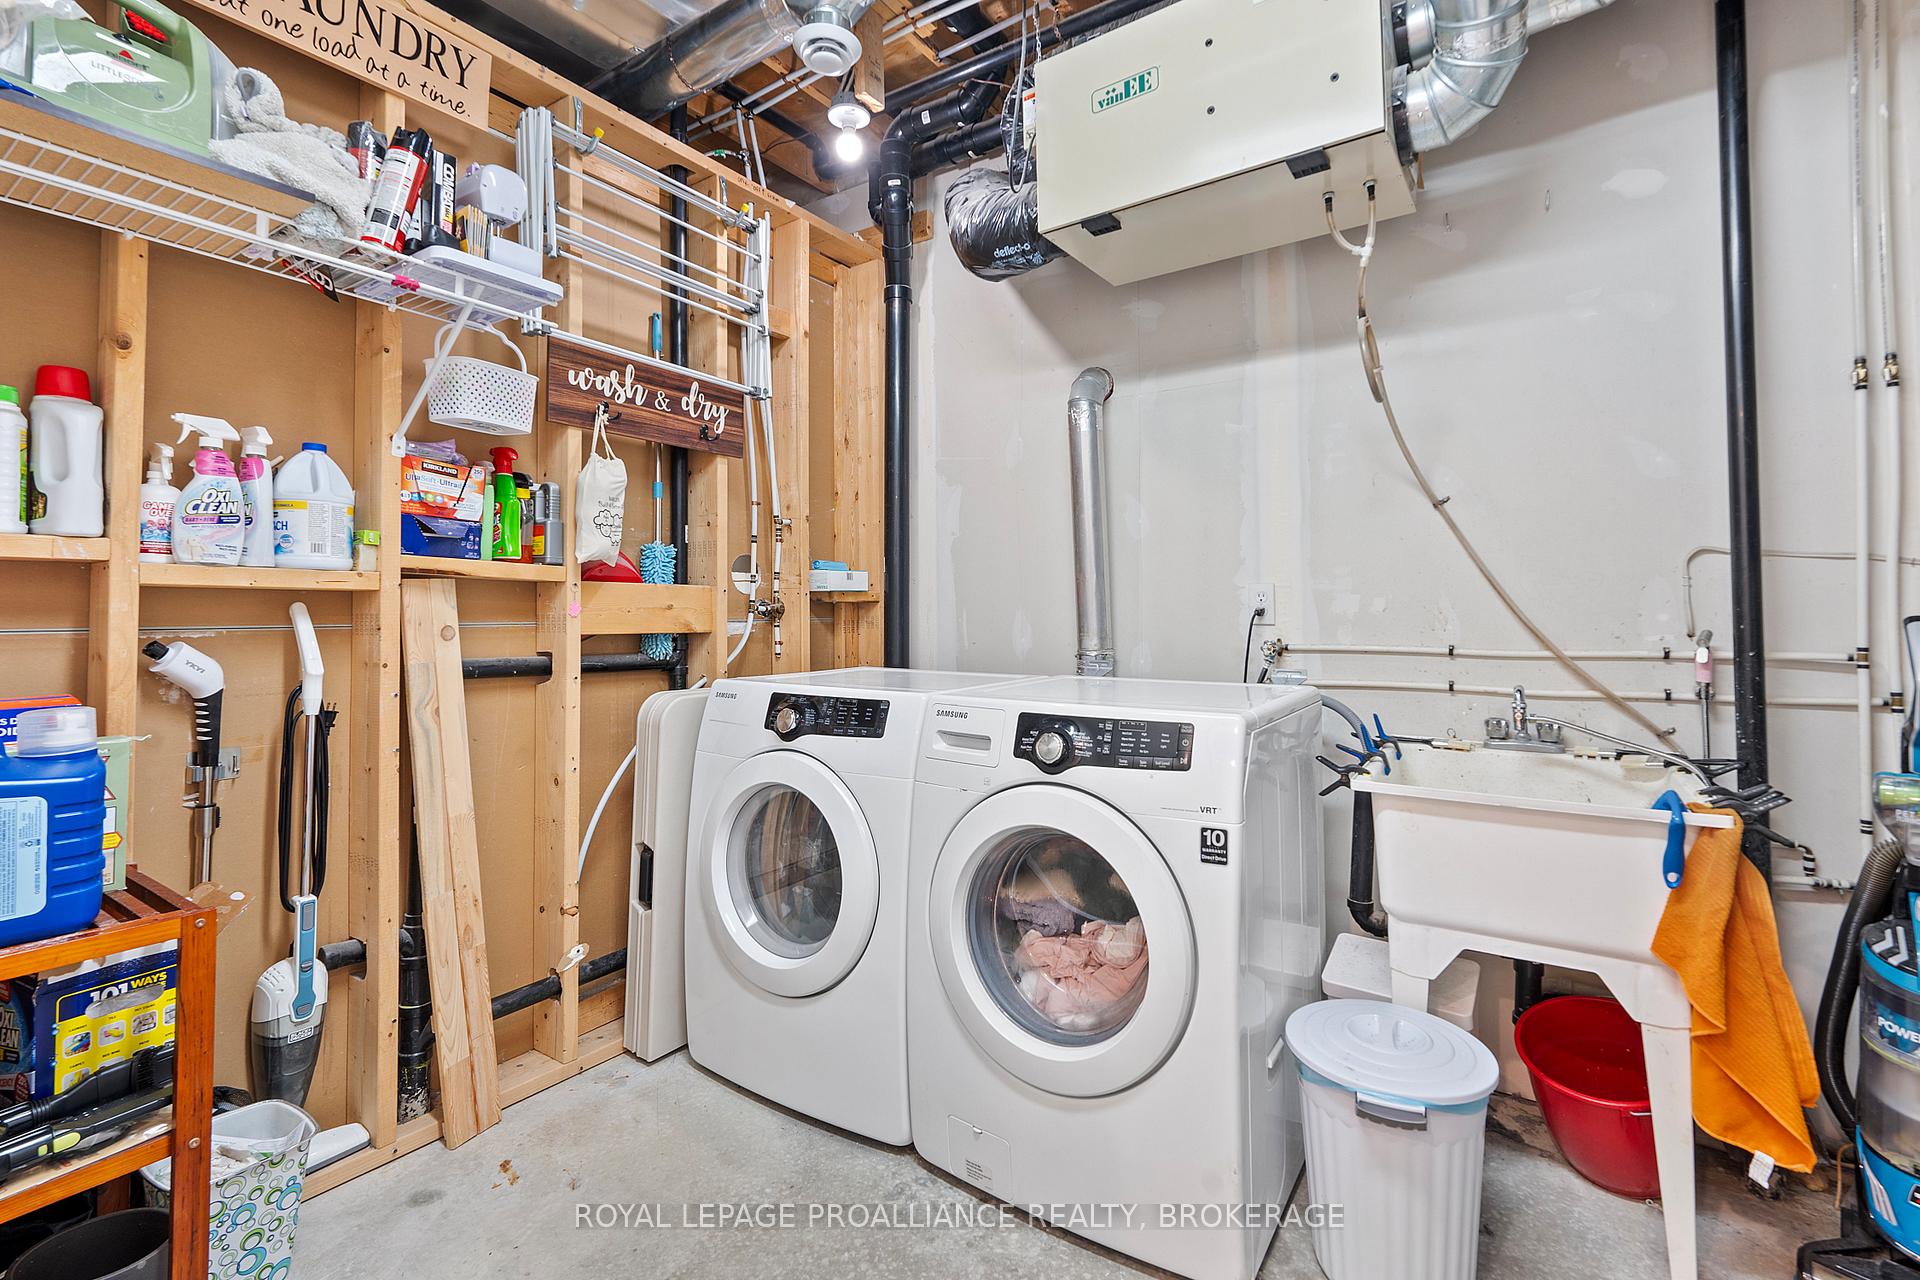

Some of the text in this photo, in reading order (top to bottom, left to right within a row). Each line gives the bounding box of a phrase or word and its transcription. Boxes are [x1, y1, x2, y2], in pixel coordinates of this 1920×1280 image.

[281, 0, 477, 90] UNDRY
[210, 0, 471, 118] ut one load at a time.
[568, 364, 730, 434] wash & dry
[422, 462, 458, 474] KIRKLAND
[201, 488, 231, 503] OXI
[143, 501, 175, 510] GAME
[150, 508, 174, 518] OVE
[185, 499, 239, 515] CLEAN
[715, 691, 738, 700] SAMSUNG
[936, 709, 969, 719] SAMSUNG
[1199, 806, 1218, 815] VRT
[1203, 830, 1225, 847] 10
[131, 971, 167, 989] WAYS
